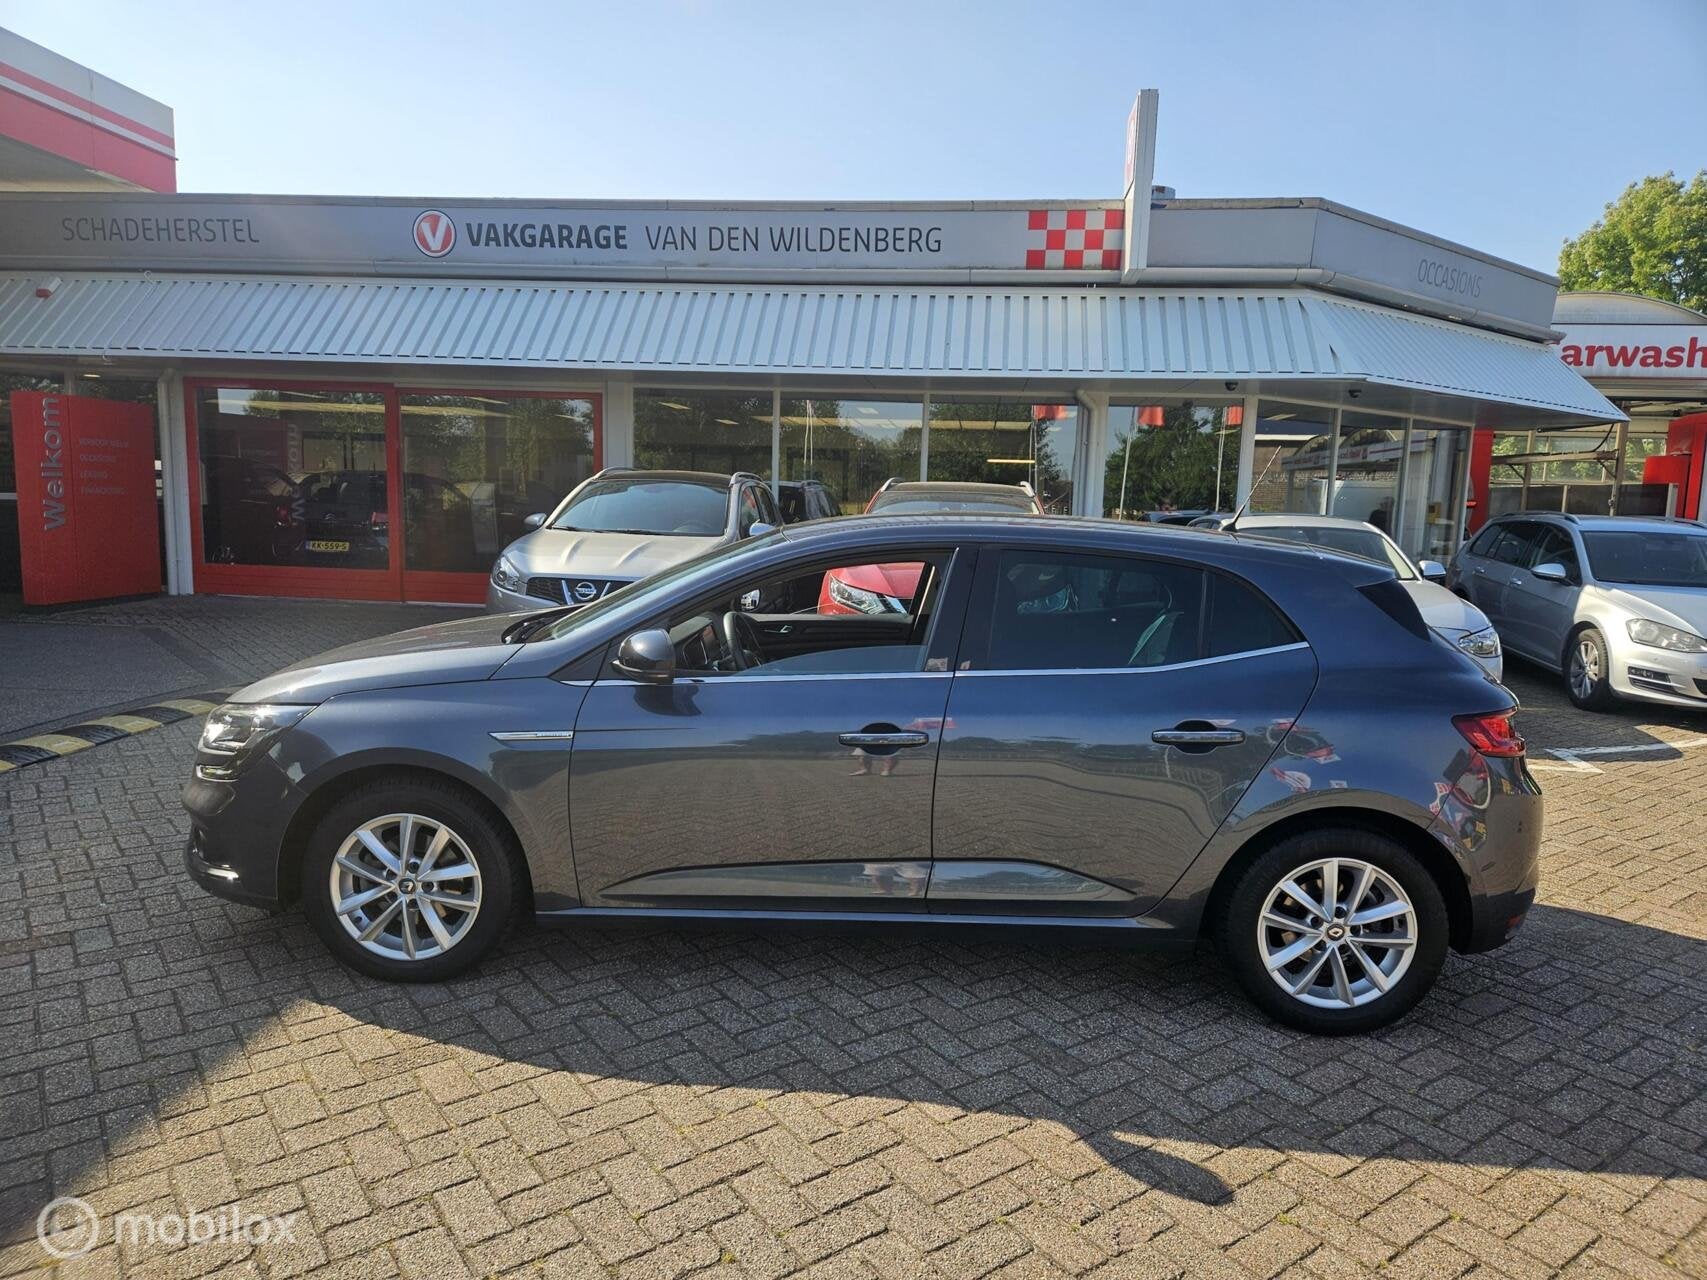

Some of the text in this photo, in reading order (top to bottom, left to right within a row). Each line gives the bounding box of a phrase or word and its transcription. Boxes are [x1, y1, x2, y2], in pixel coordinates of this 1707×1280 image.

[61, 217, 260, 243] SCHADEHERSTEL
[466, 222, 943, 253] VAKGARAGE VAN DEN WILDENBERG
[1417, 258, 1483, 298] OCCASIONS
[1560, 337, 1707, 368] arwash
[41, 396, 67, 532] Welkom
